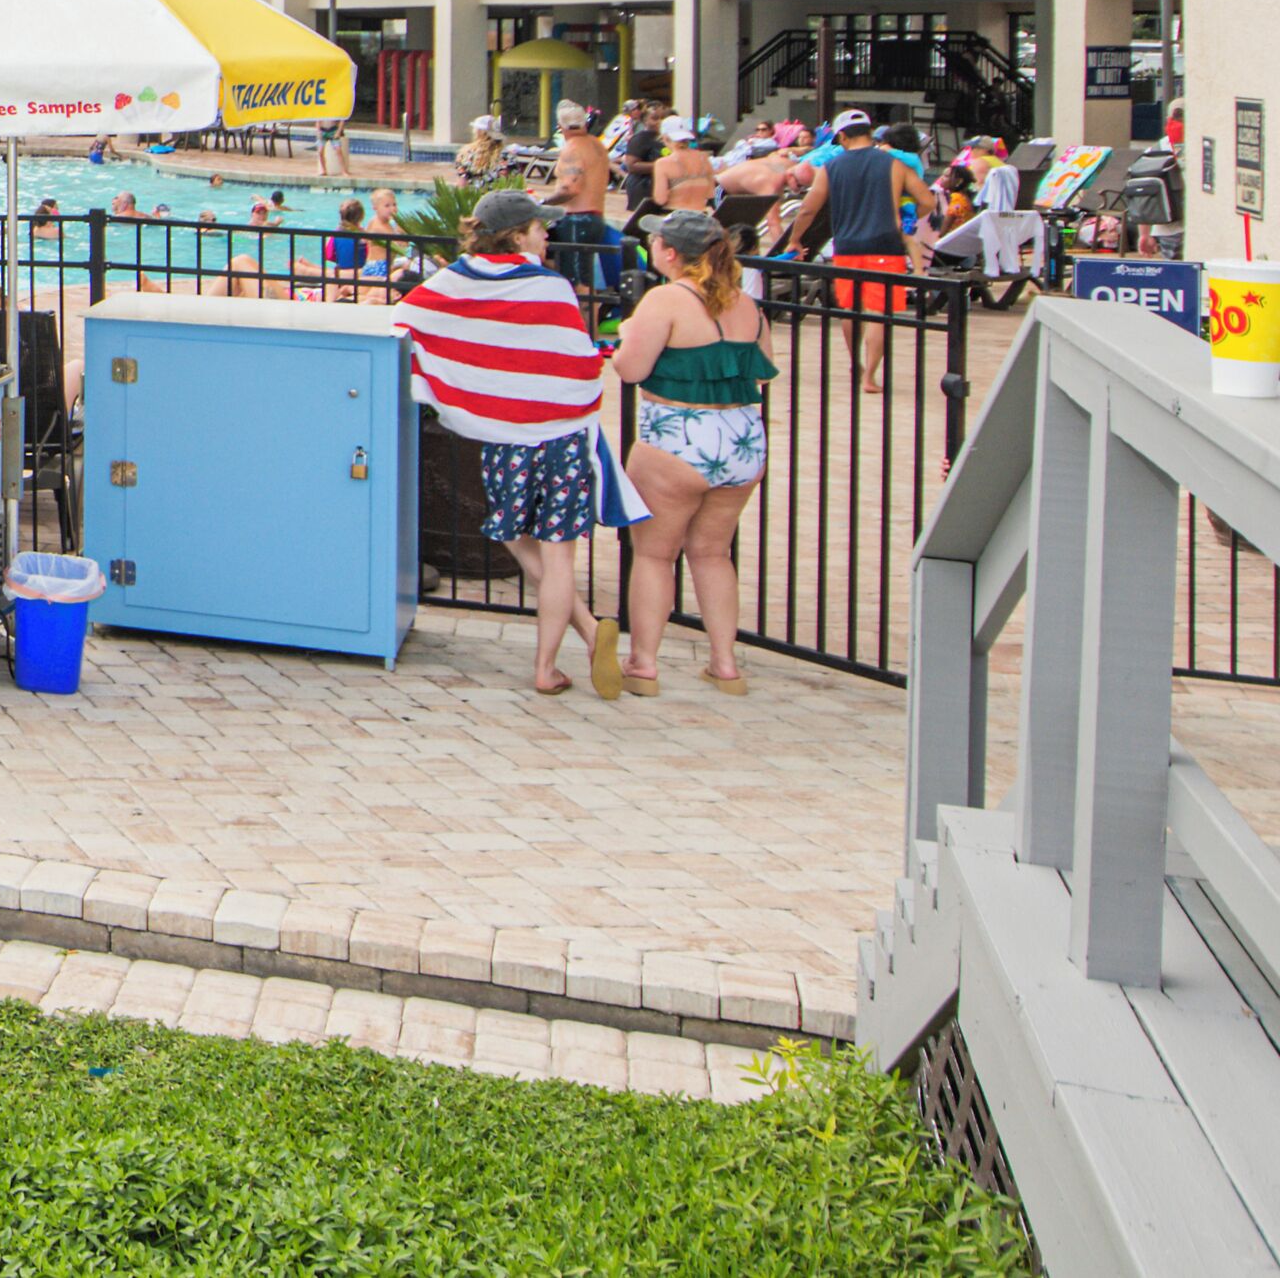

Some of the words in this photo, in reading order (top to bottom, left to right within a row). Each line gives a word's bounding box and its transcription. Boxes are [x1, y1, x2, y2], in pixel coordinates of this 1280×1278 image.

[293, 79, 327, 106] ICE
[27, 101, 102, 118] Samples
[1090, 286, 1184, 313] OPEN
